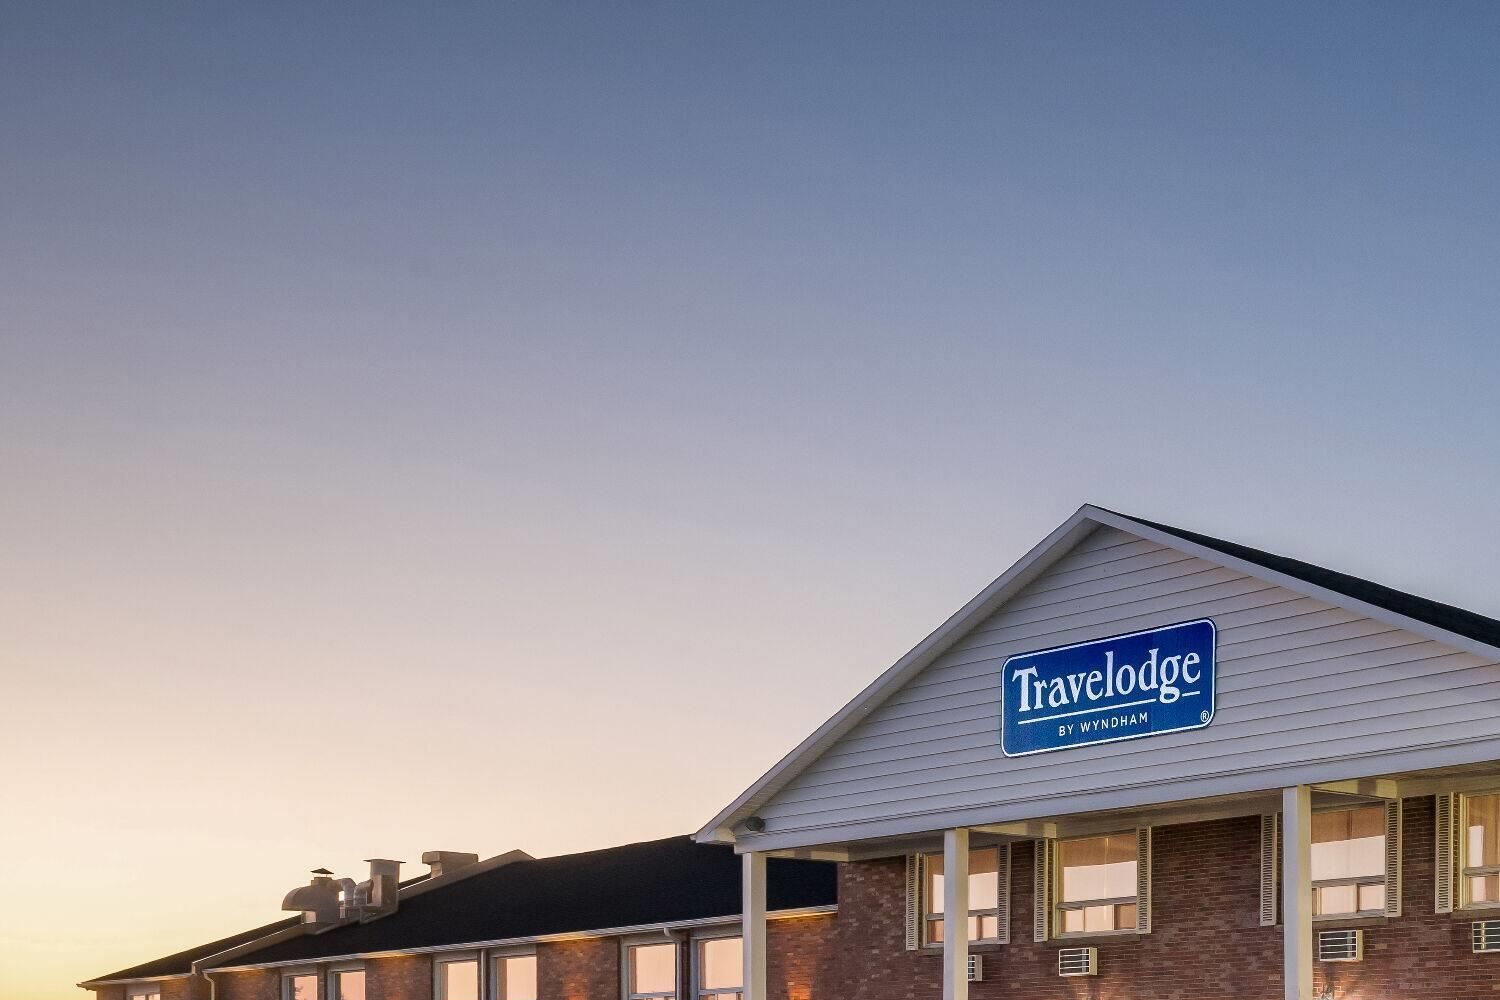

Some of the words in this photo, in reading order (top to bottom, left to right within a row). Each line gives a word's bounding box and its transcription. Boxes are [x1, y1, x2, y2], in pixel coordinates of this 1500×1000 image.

[1012, 648, 1201, 712] Travelodge
[1058, 724, 1074, 737] BY
[1081, 712, 1148, 733] WYNDHAM
